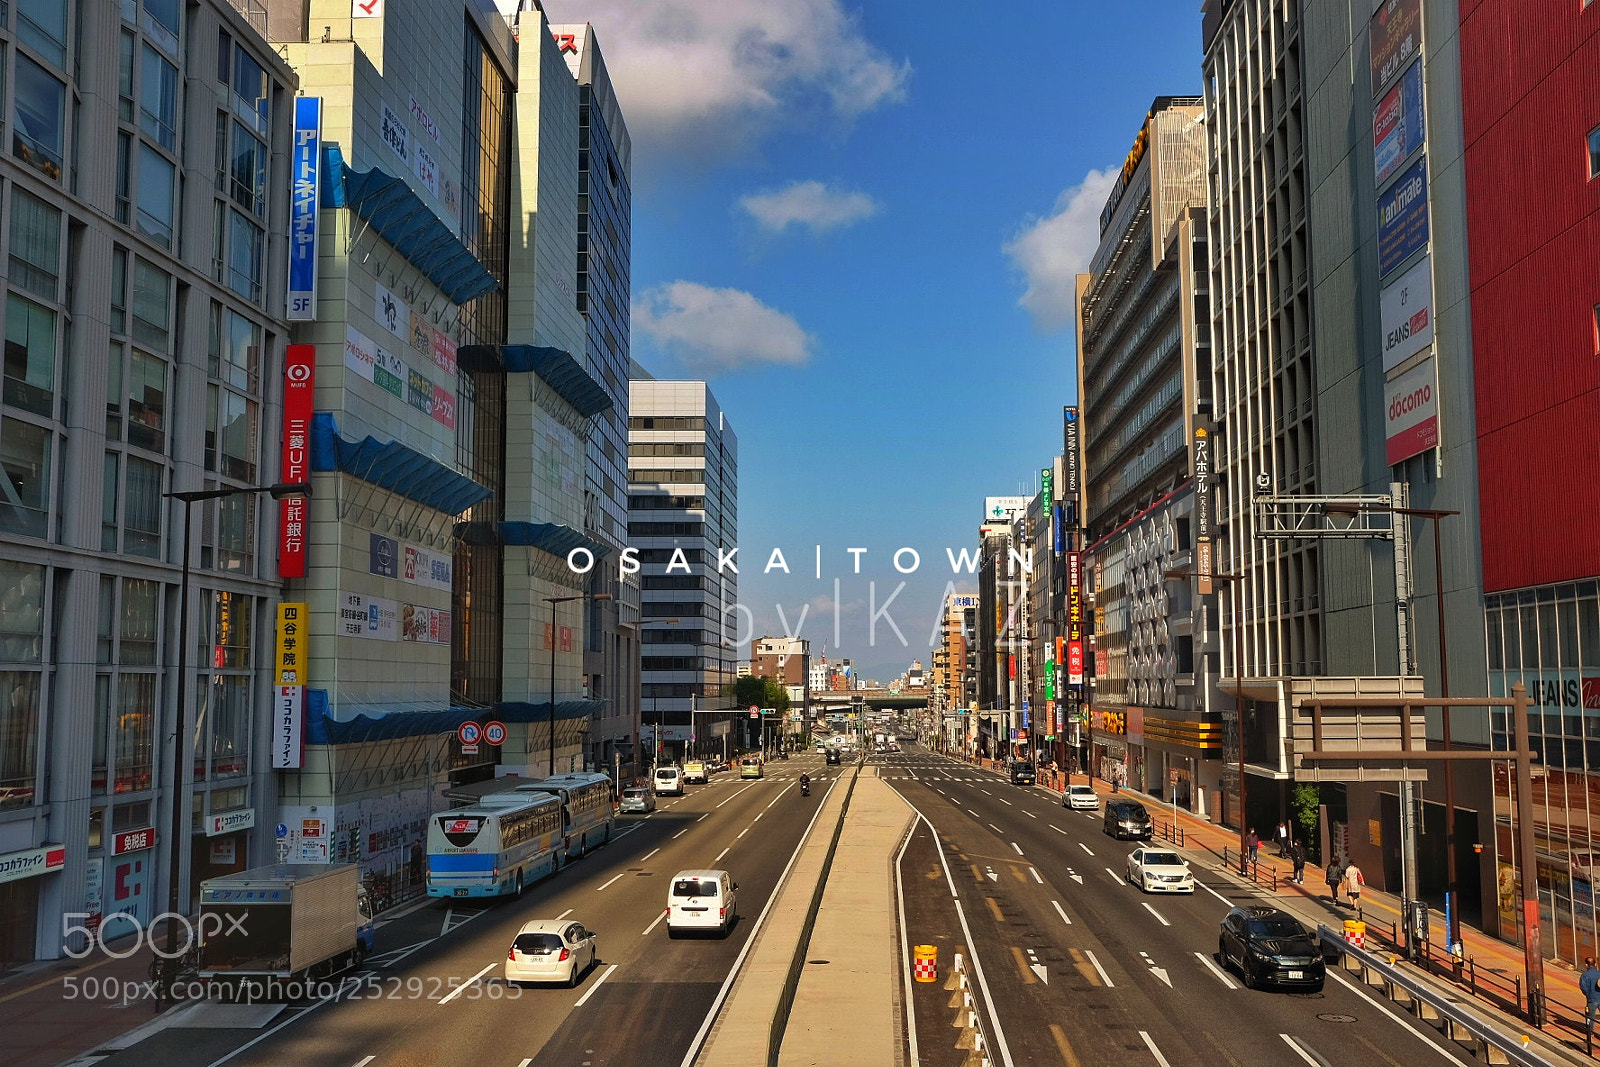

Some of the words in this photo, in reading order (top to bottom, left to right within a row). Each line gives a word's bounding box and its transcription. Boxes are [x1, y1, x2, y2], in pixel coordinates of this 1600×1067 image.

[293, 129, 317, 260] アートネイチャー
[292, 298, 310, 312] 5F
[1400, 286, 1409, 306] 2F
[1385, 321, 1410, 352] JEANS
[1388, 384, 1431, 422] docomo
[282, 607, 298, 666] 四谷学院
[1529, 679, 1579, 707] JEANS
[283, 699, 292, 767] ココカラファイン
[489, 728, 502, 739] 40
[124, 832, 148, 850] 免税店
